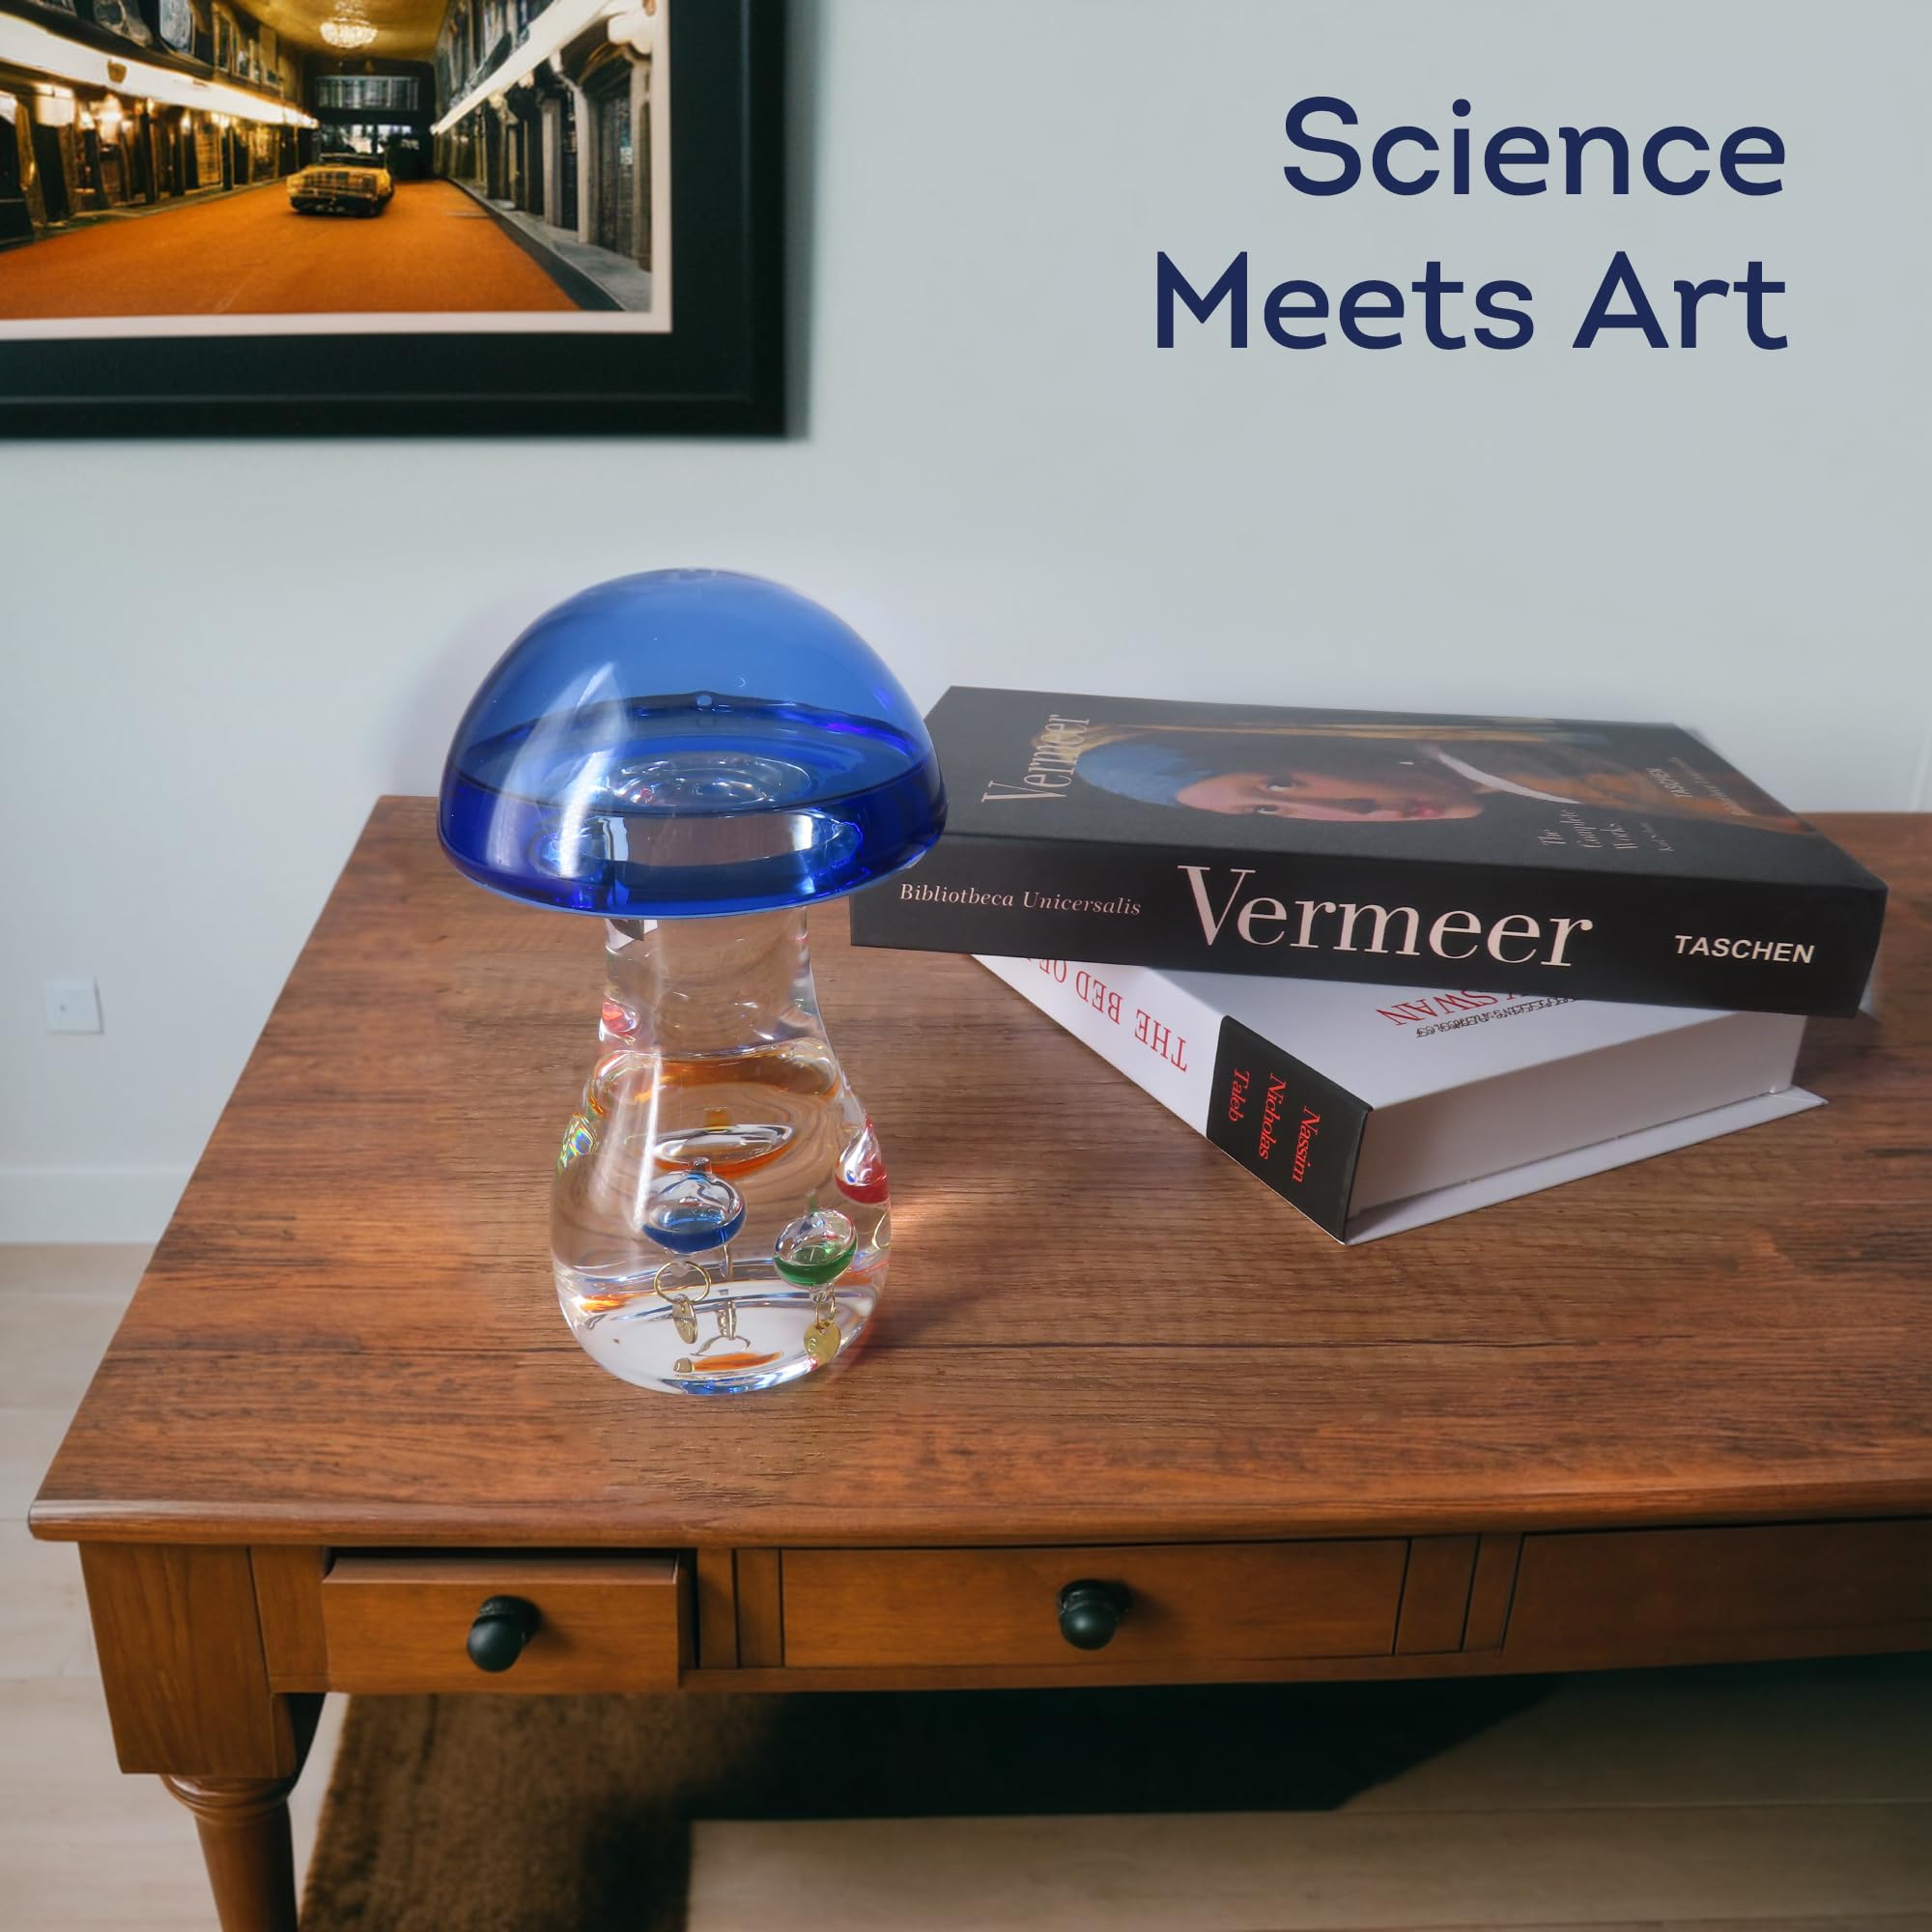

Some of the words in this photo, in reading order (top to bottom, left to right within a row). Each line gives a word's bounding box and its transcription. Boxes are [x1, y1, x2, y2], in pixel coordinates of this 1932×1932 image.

[981, 714, 1090, 803] Vermeer
[1177, 865, 1594, 968] Vermeer
[1674, 934, 1816, 964] TASCHEN
[1075, 970, 1123, 1025] BED
[1375, 990, 1498, 1026] SWAN
[1133, 1009, 1189, 1072] THE
[1228, 1068, 1250, 1122] Taleb
[1258, 1072, 1287, 1160] Nicholas
[1292, 1105, 1321, 1182] Nassim
